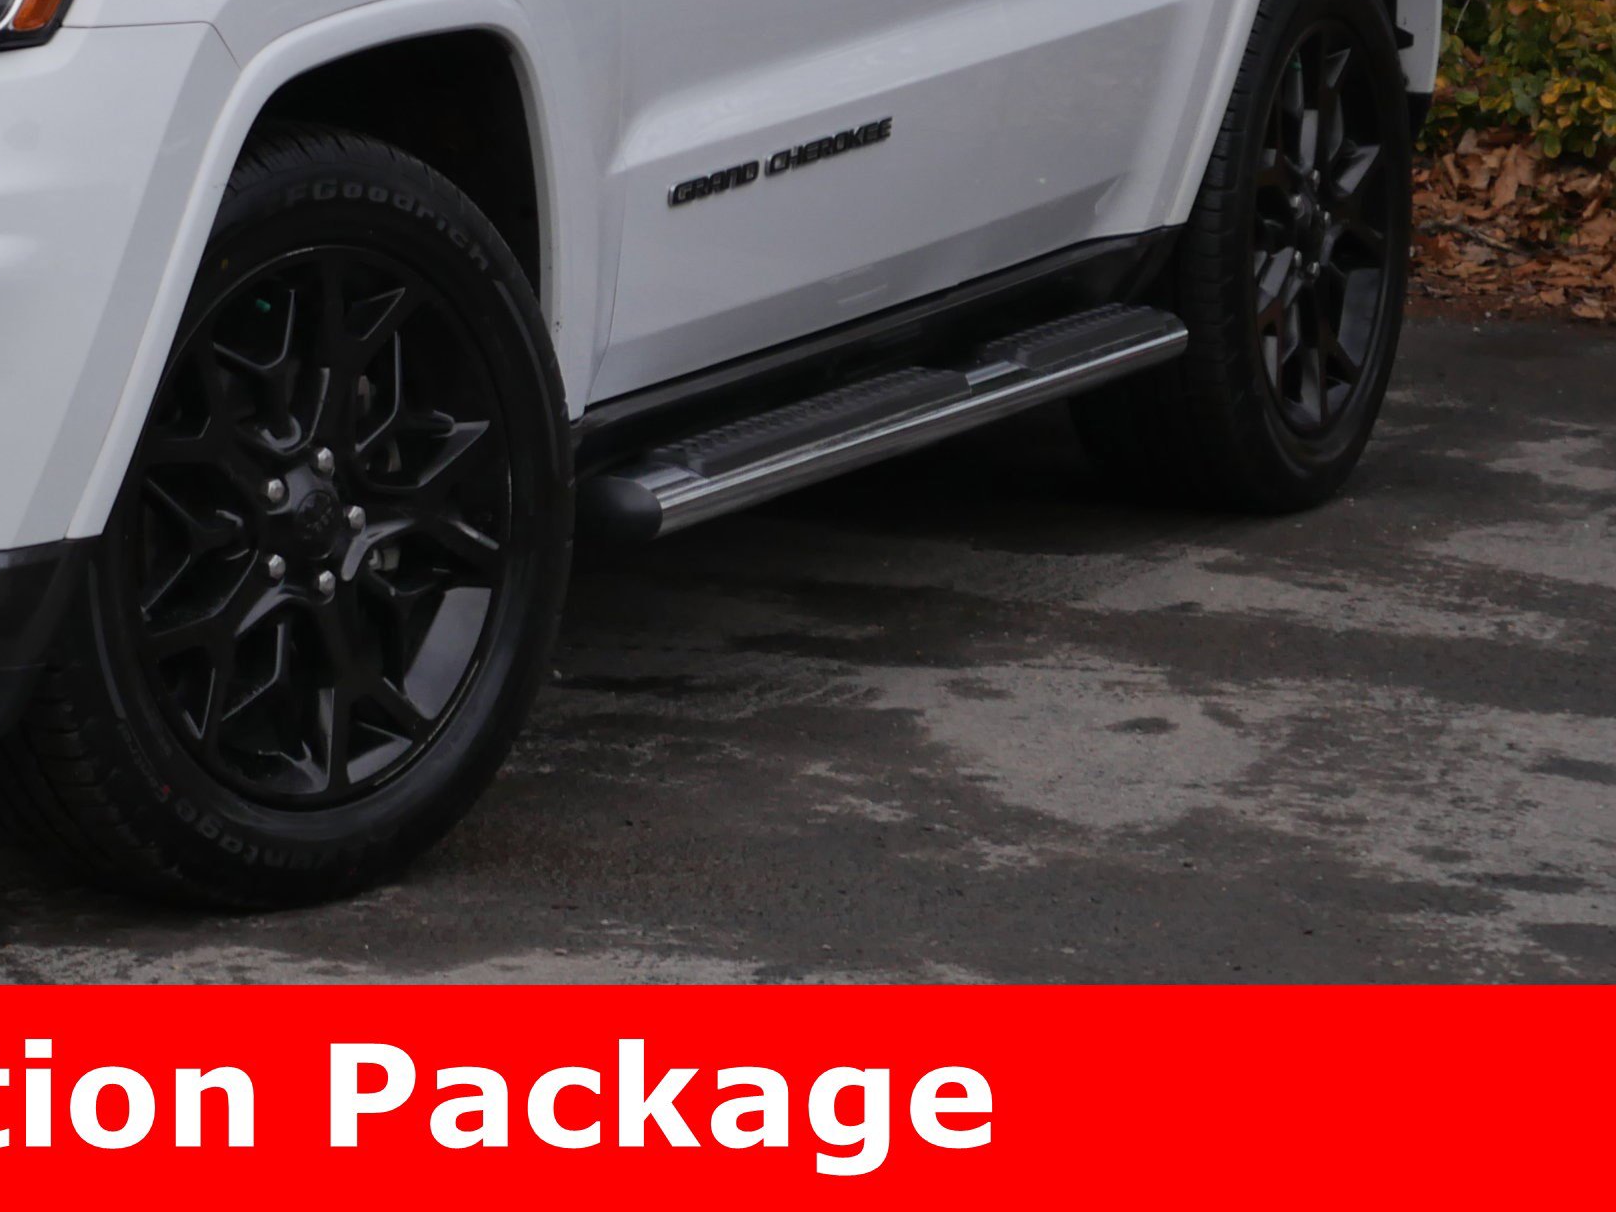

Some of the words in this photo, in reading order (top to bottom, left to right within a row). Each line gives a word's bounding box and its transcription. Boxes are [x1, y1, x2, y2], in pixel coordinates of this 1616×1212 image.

[668, 160, 759, 207] GRAND
[765, 117, 893, 178] CHEROKEE
[264, 178, 489, 272] FGoodrich
